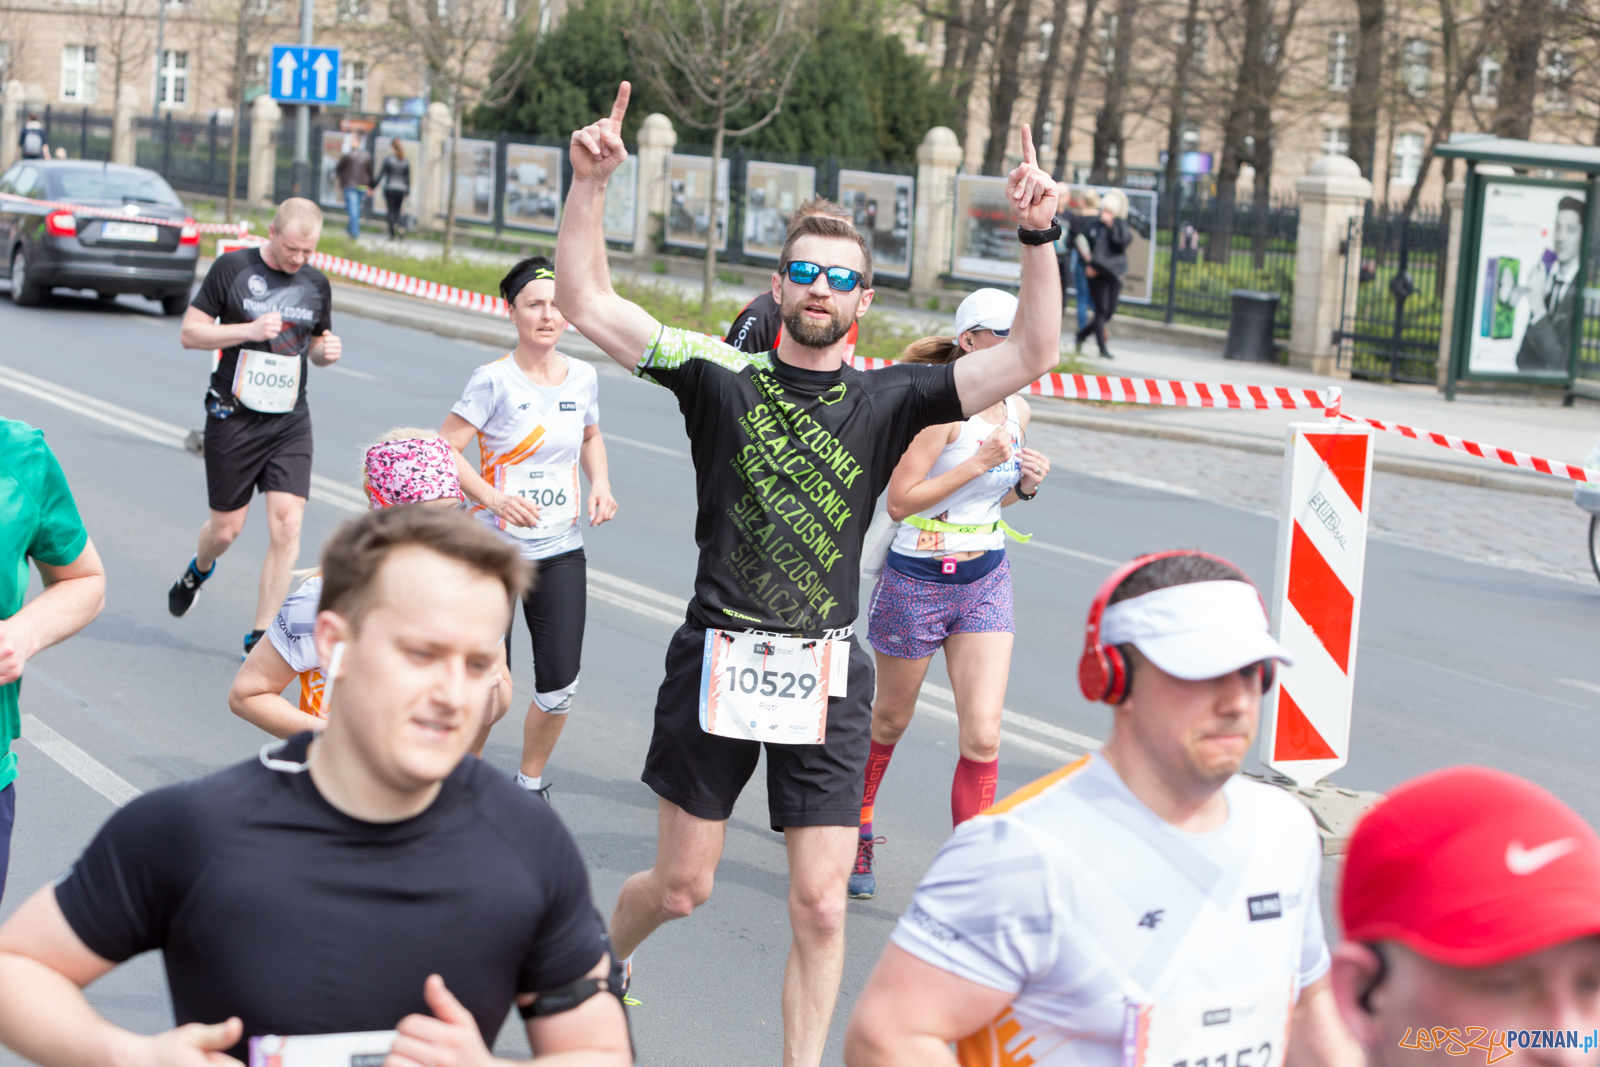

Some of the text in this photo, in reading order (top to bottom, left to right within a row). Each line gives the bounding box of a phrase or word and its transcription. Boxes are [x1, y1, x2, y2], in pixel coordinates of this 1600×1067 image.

[246, 370, 295, 388] 10056
[750, 374, 790, 430] EXTREME FUN BRAND
[738, 416, 780, 472] EXTREME FUN BRAND
[518, 488, 567, 506] 1306
[729, 458, 771, 514] EXTREME FUN BRAND
[726, 508, 768, 562] EXTREME FUN BRAND
[726, 666, 816, 700] 10529
[758, 702, 778, 711] Piotr
